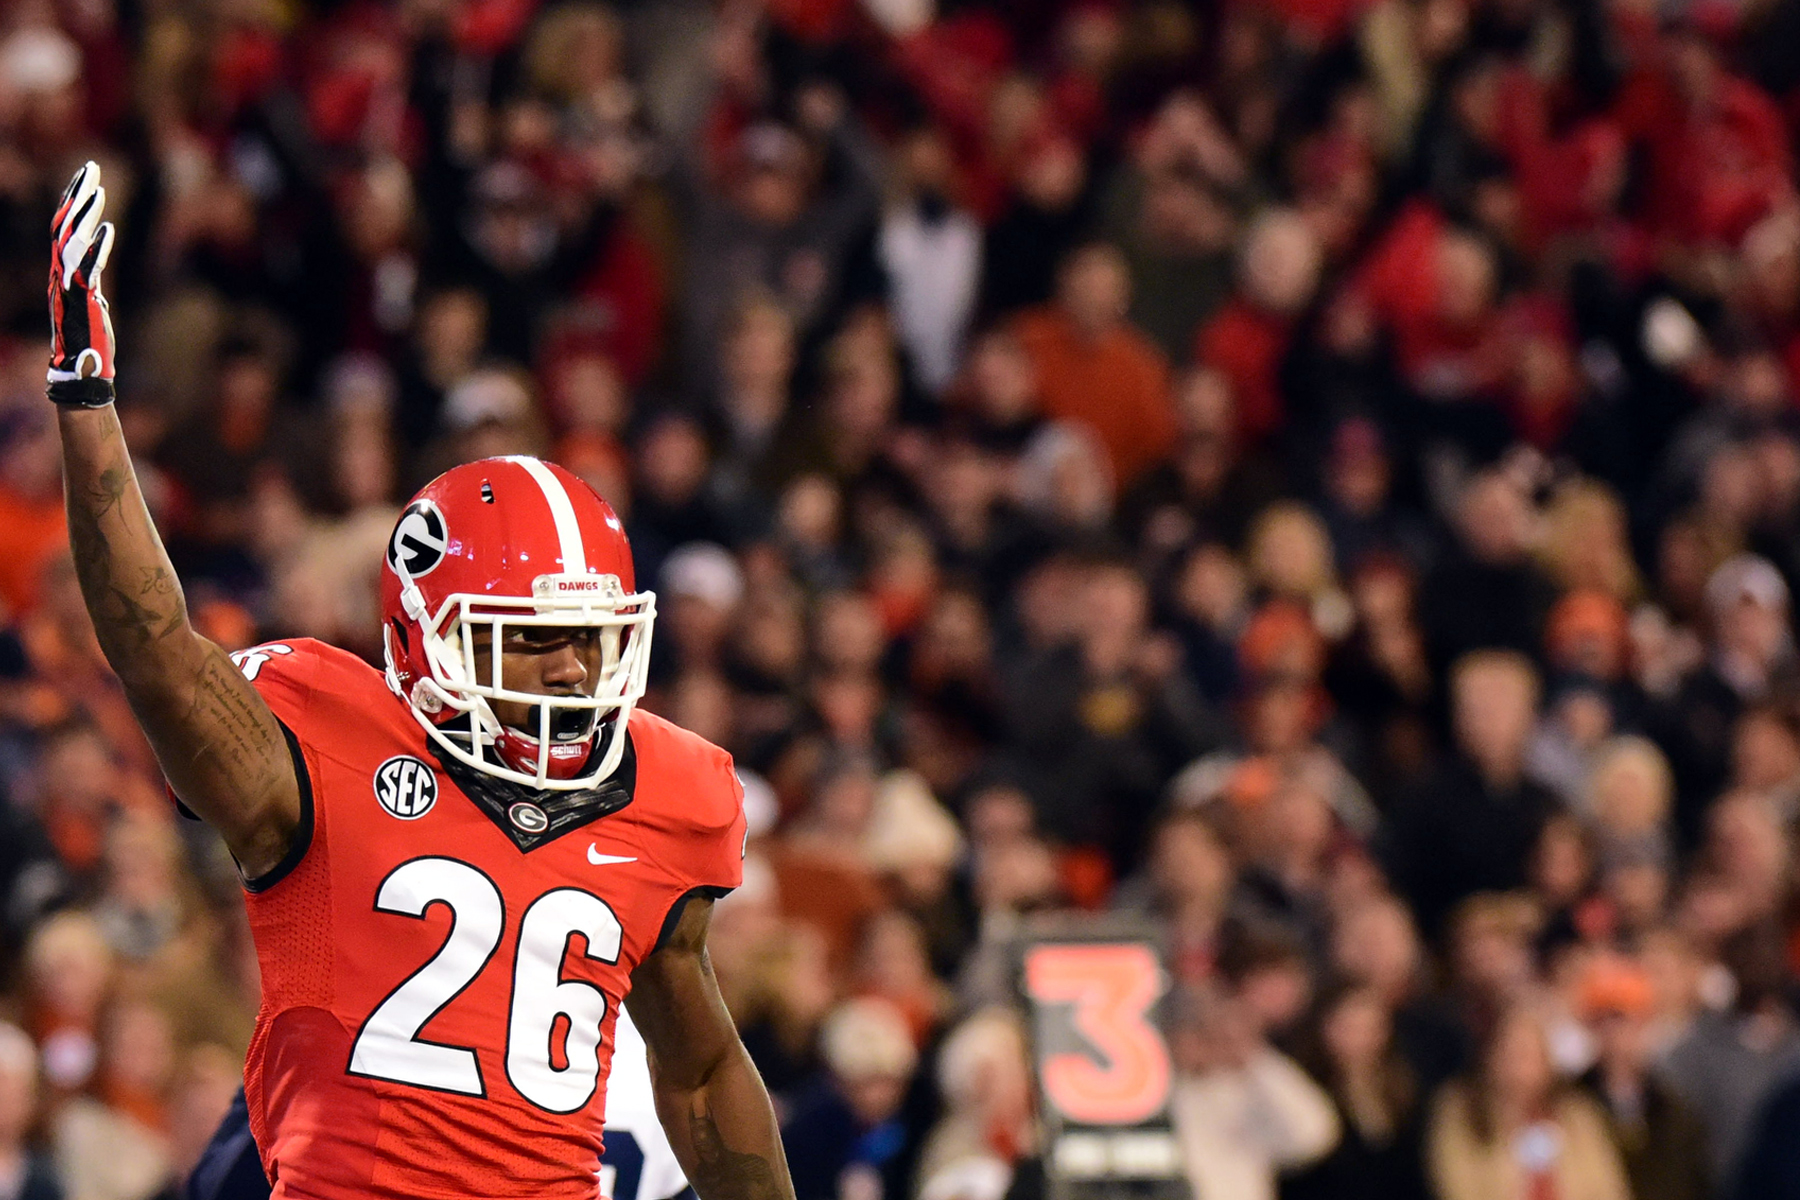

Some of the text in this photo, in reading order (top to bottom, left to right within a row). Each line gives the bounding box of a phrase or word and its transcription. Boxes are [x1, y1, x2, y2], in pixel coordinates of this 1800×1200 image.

[559, 581, 598, 591] DAWGS
[379, 760, 432, 815] SEC
[510, 803, 547, 832] G
[345, 855, 624, 1115] 26
[1026, 946, 1169, 1122] 3
